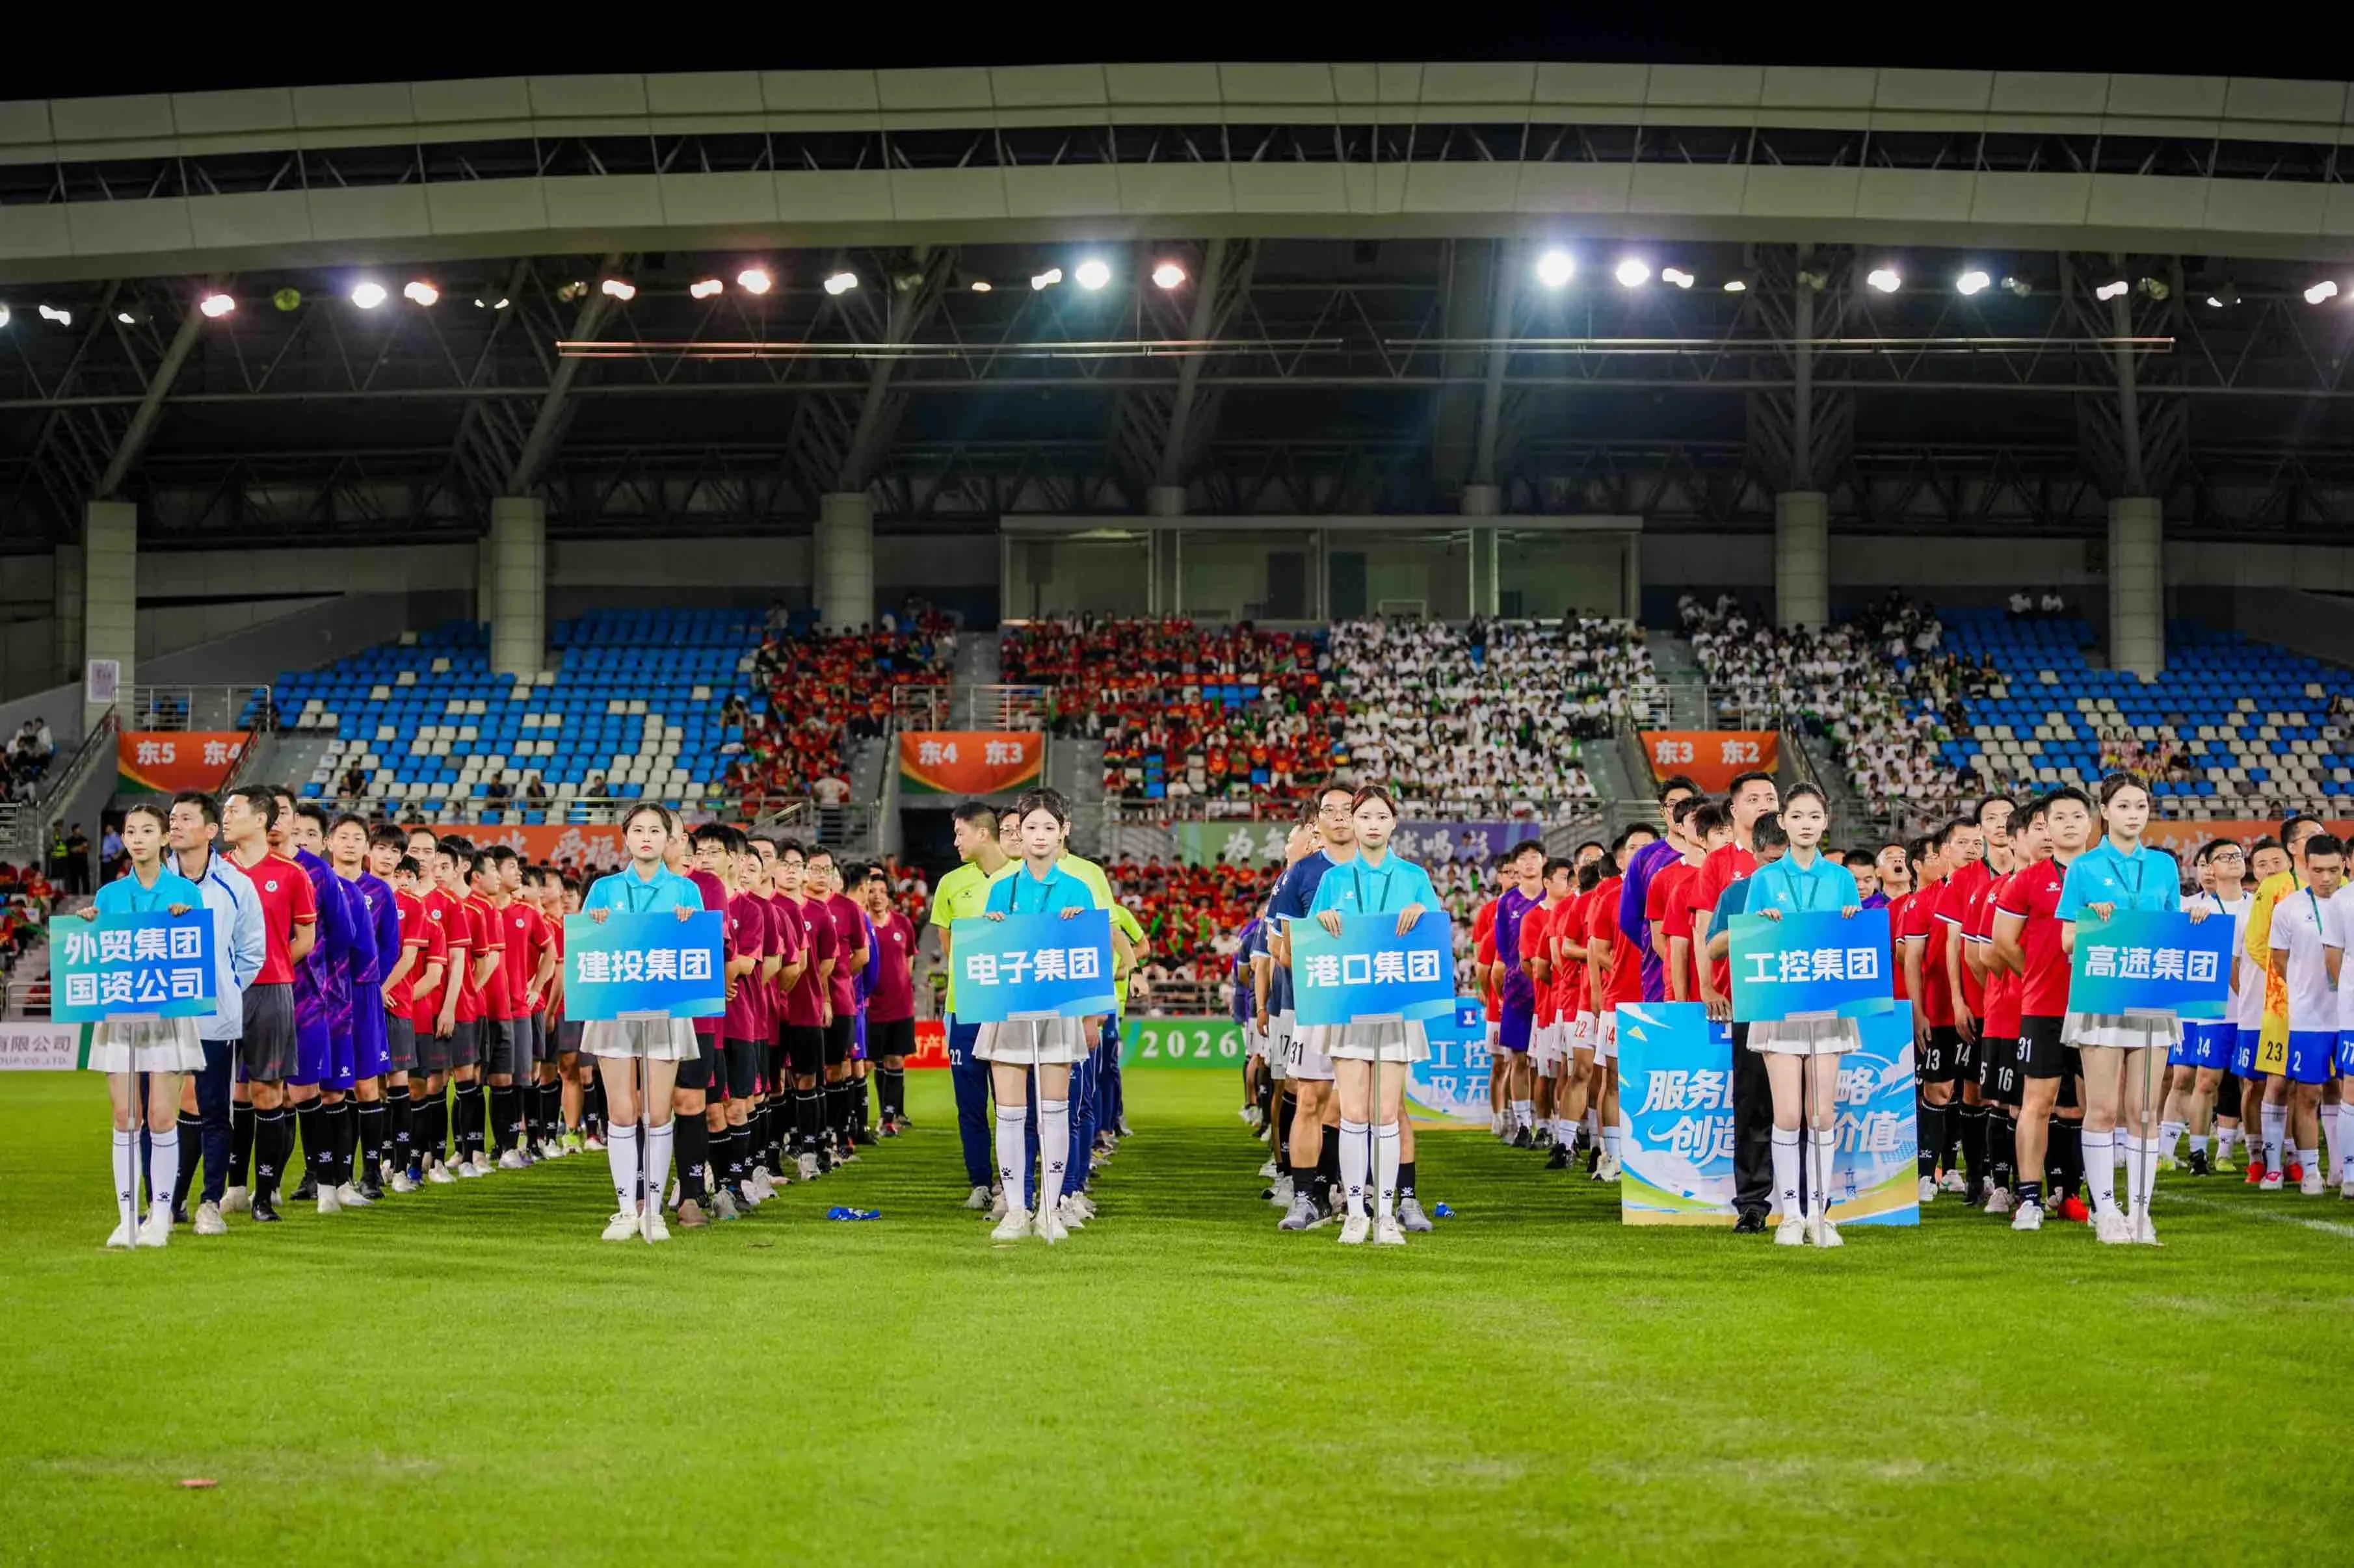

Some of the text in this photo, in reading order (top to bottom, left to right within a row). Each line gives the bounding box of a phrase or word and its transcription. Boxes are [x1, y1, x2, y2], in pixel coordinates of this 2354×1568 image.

[136, 740, 242, 766] 东5 东4
[918, 740, 1024, 766] 东4 东3
[1655, 738, 1760, 765] 东3 东2
[64, 926, 202, 965] 外贸集团
[577, 948, 712, 983] 建投集团
[966, 947, 1100, 986] 电子集团
[1304, 950, 1441, 988] 港口集团
[1744, 947, 1879, 983] 工控集团
[2085, 945, 2219, 982] 高速集团
[66, 967, 204, 1006] 国资公司
[1141, 1029, 1238, 1058] 2026
[1279, 1034, 1291, 1056] 17
[1290, 1041, 1304, 1065] 31
[1955, 1043, 1971, 1067] 14
[2017, 1037, 2032, 1063] 31
[2265, 1041, 2282, 1062] 23
[949, 1049, 962, 1065] 22
[1925, 1047, 1940, 1071] 13
[2292, 1051, 2301, 1072] 2
[1998, 1066, 2013, 1092] 16
[1634, 1069, 1734, 1116] 服务
